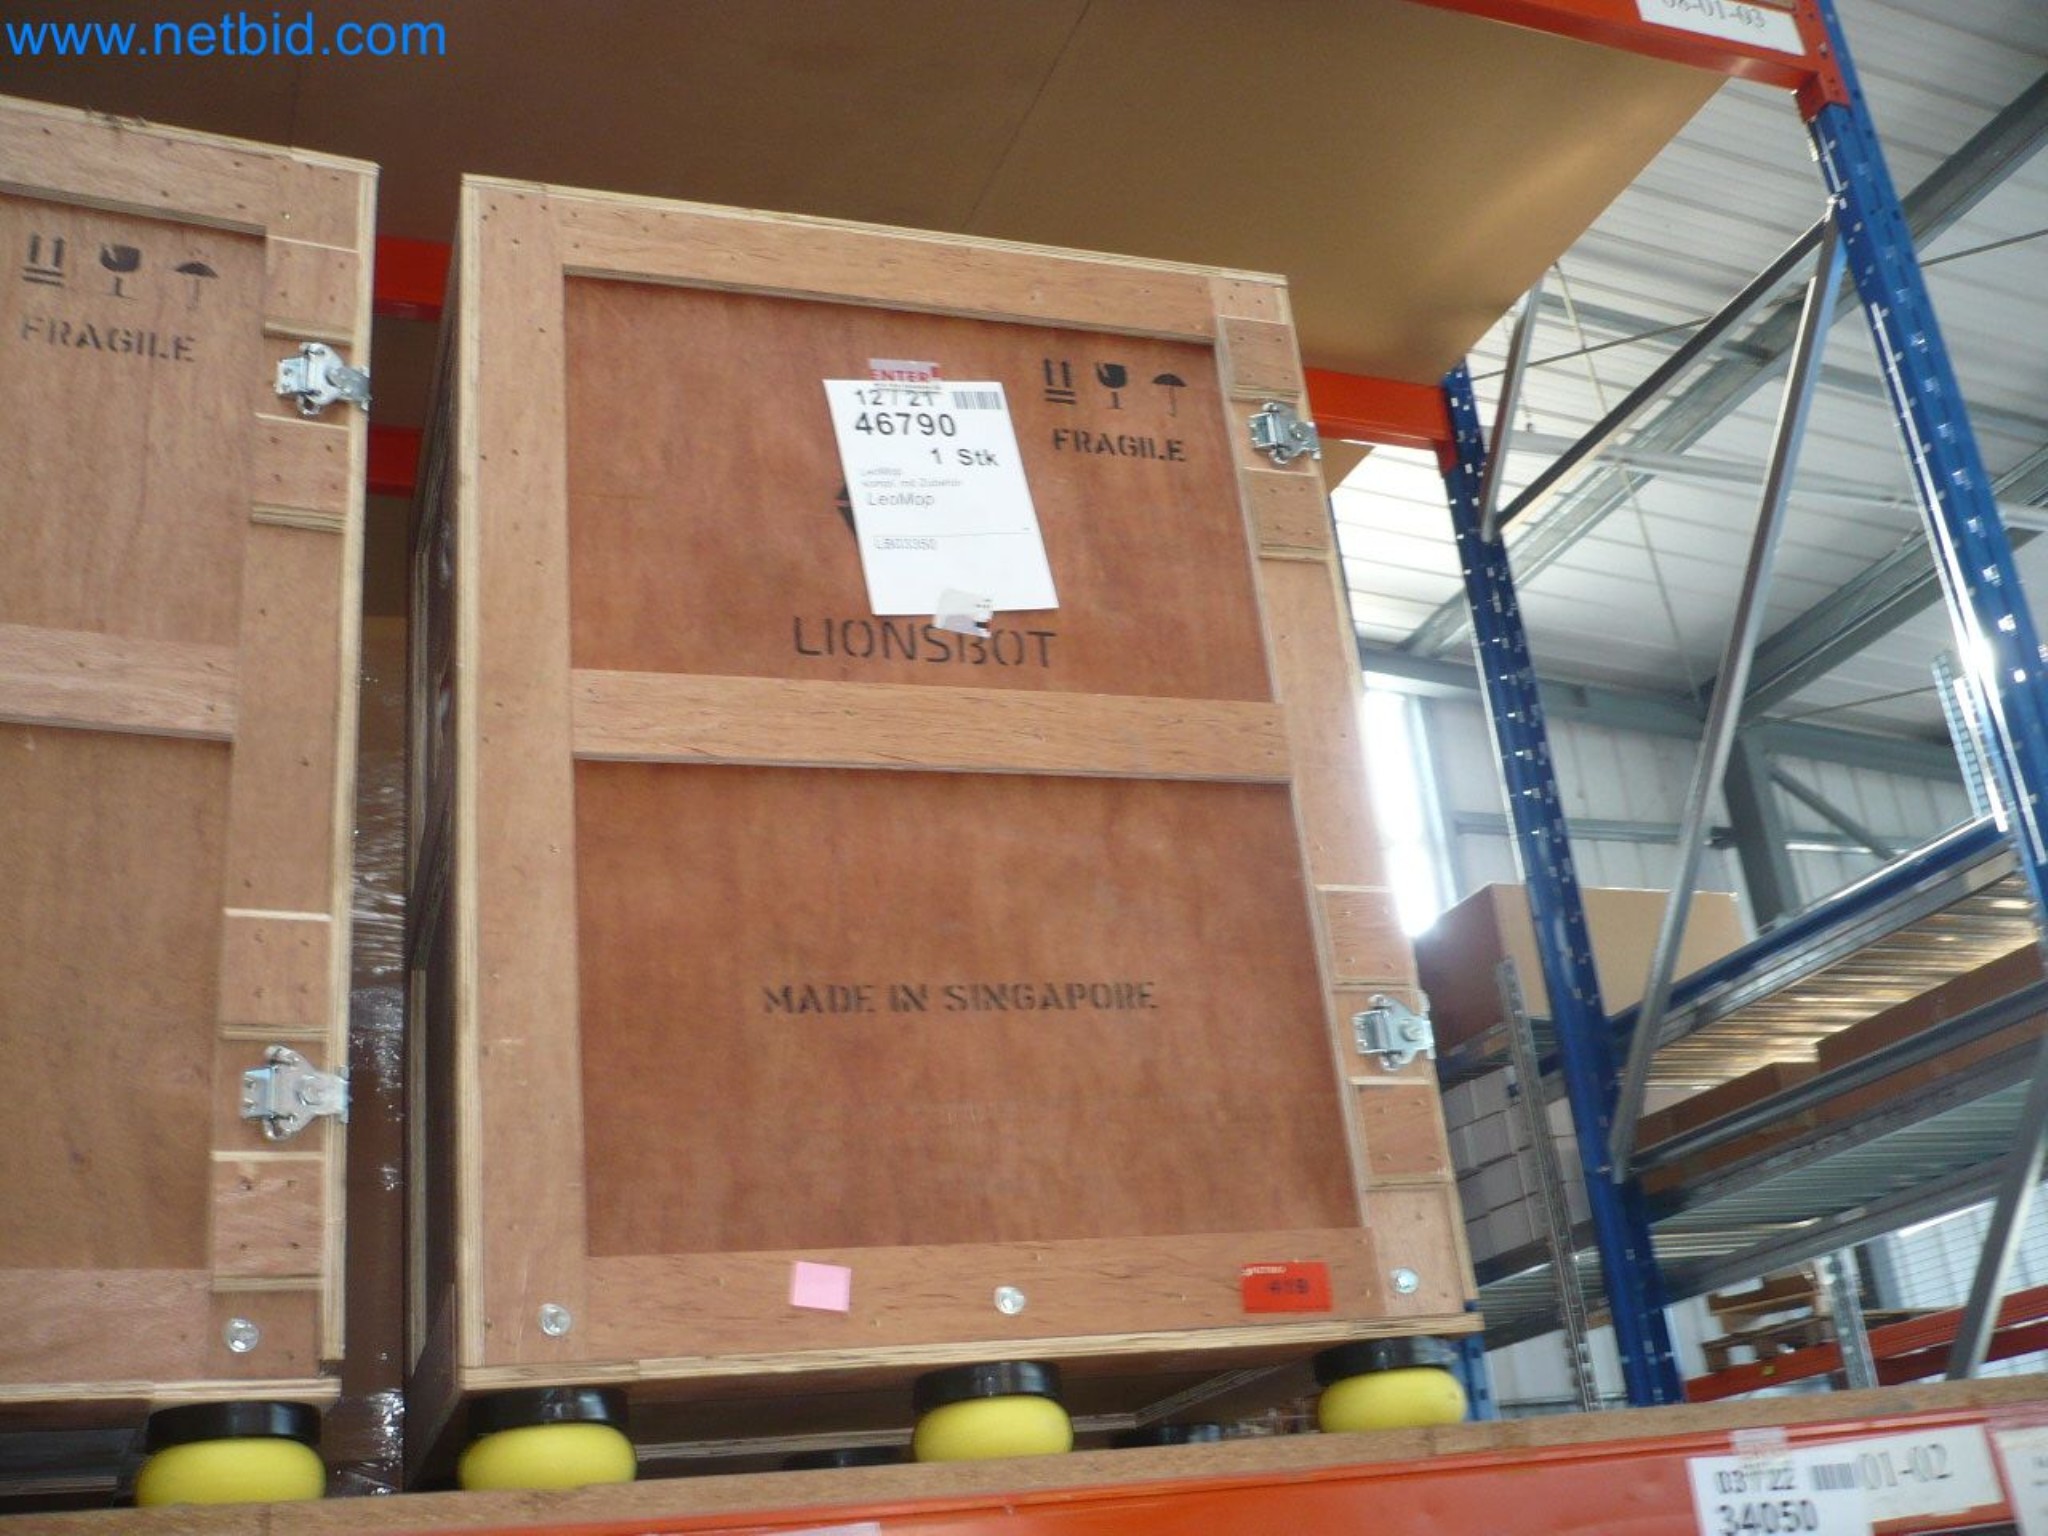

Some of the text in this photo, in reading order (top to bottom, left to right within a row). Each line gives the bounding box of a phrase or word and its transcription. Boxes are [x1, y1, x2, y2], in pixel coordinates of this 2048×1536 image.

[21, 315, 197, 363] FRAGILE
[855, 411, 957, 438] 46790
[930, 447, 1000, 467] 1 Stk
[1052, 427, 1187, 462] FRAGILE
[793, 615, 1057, 667] LIONSBOT
[761, 981, 1159, 1014] MADE IN SINGAPORE
[1716, 1499, 1819, 1536] 34050
